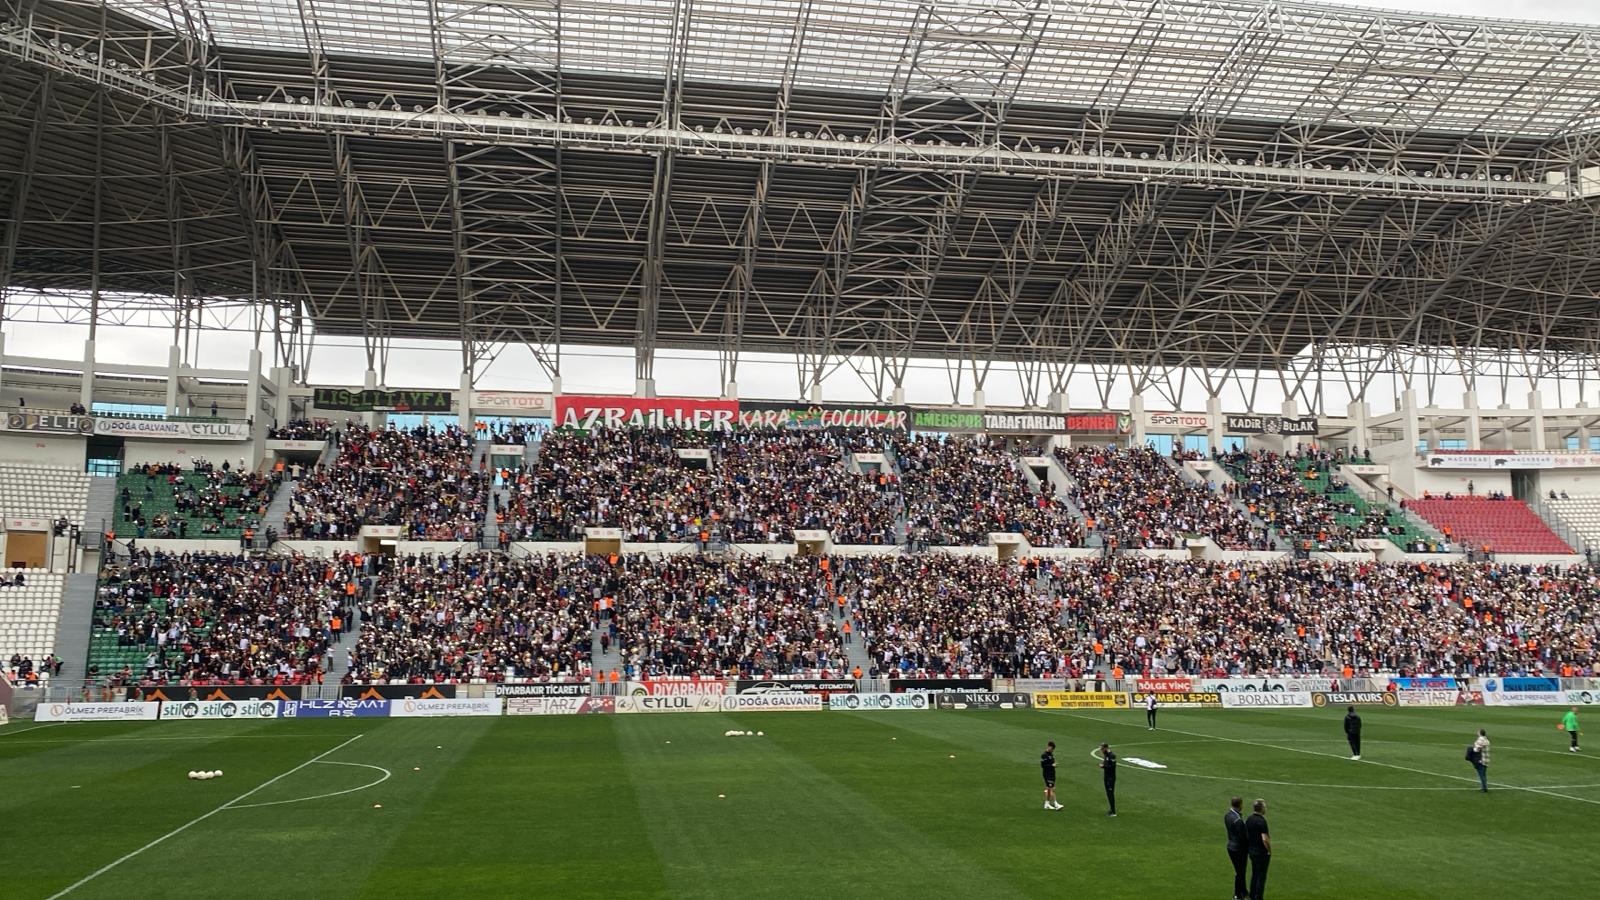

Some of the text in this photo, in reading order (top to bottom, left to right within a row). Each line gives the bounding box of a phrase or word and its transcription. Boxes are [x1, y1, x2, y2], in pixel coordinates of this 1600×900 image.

[387, 391, 446, 406] TAYFA
[739, 409, 790, 430] KARA
[914, 412, 982, 428] AMEDSPOR
[984, 414, 1066, 430] TARAFTARLAR
[1229, 417, 1315, 432] KADİR BULAK
[496, 683, 590, 696] DİYARBAKIR TİCARET VE
[653, 682, 723, 695] DİYARBAKIR
[740, 695, 821, 706] DOĞA GALVANİZ
[1190, 693, 1219, 702] SPOR
[1239, 694, 1279, 705] BORAN
[1327, 693, 1383, 702] TESLA KURS
